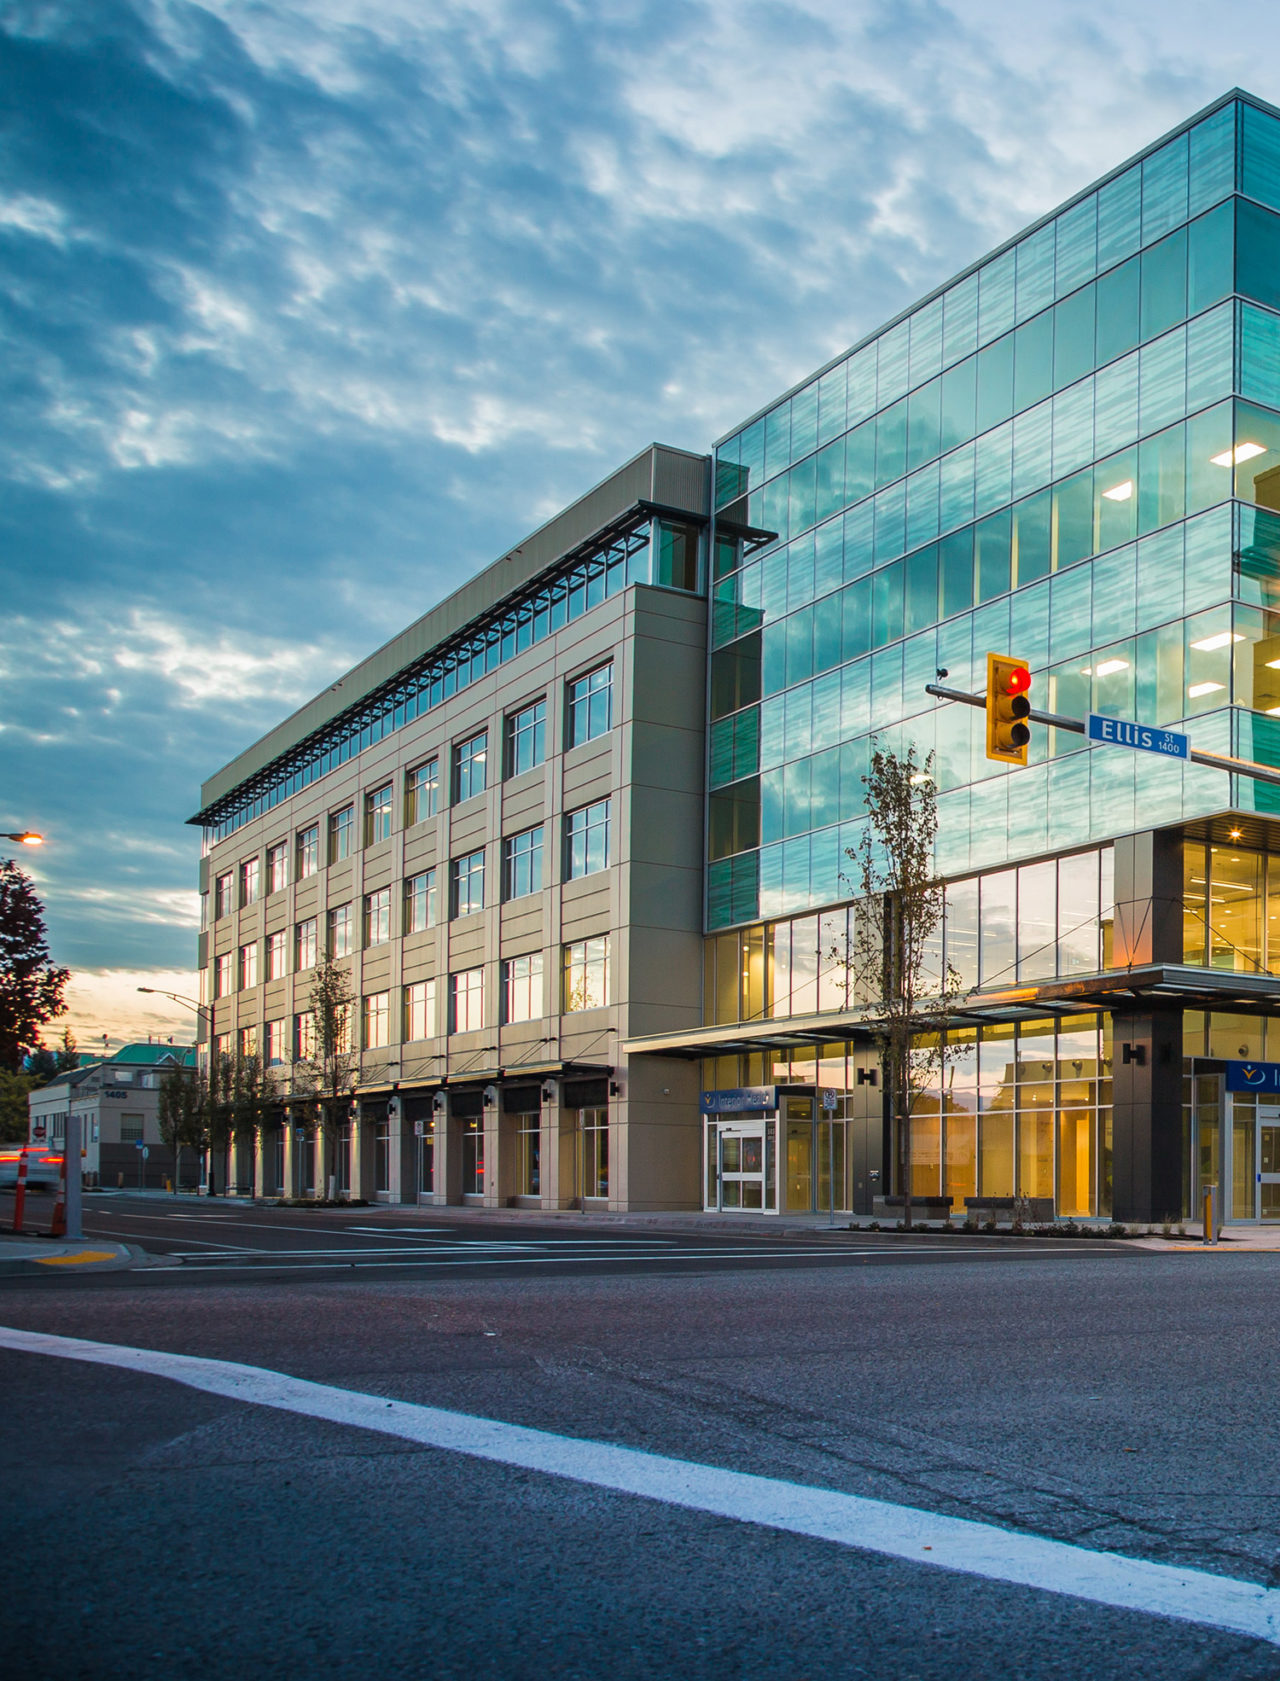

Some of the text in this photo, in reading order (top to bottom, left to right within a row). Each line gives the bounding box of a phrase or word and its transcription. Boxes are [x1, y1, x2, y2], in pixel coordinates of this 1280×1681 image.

[1102, 720, 1174, 747] Ellis St
[1158, 741, 1180, 753] 1400
